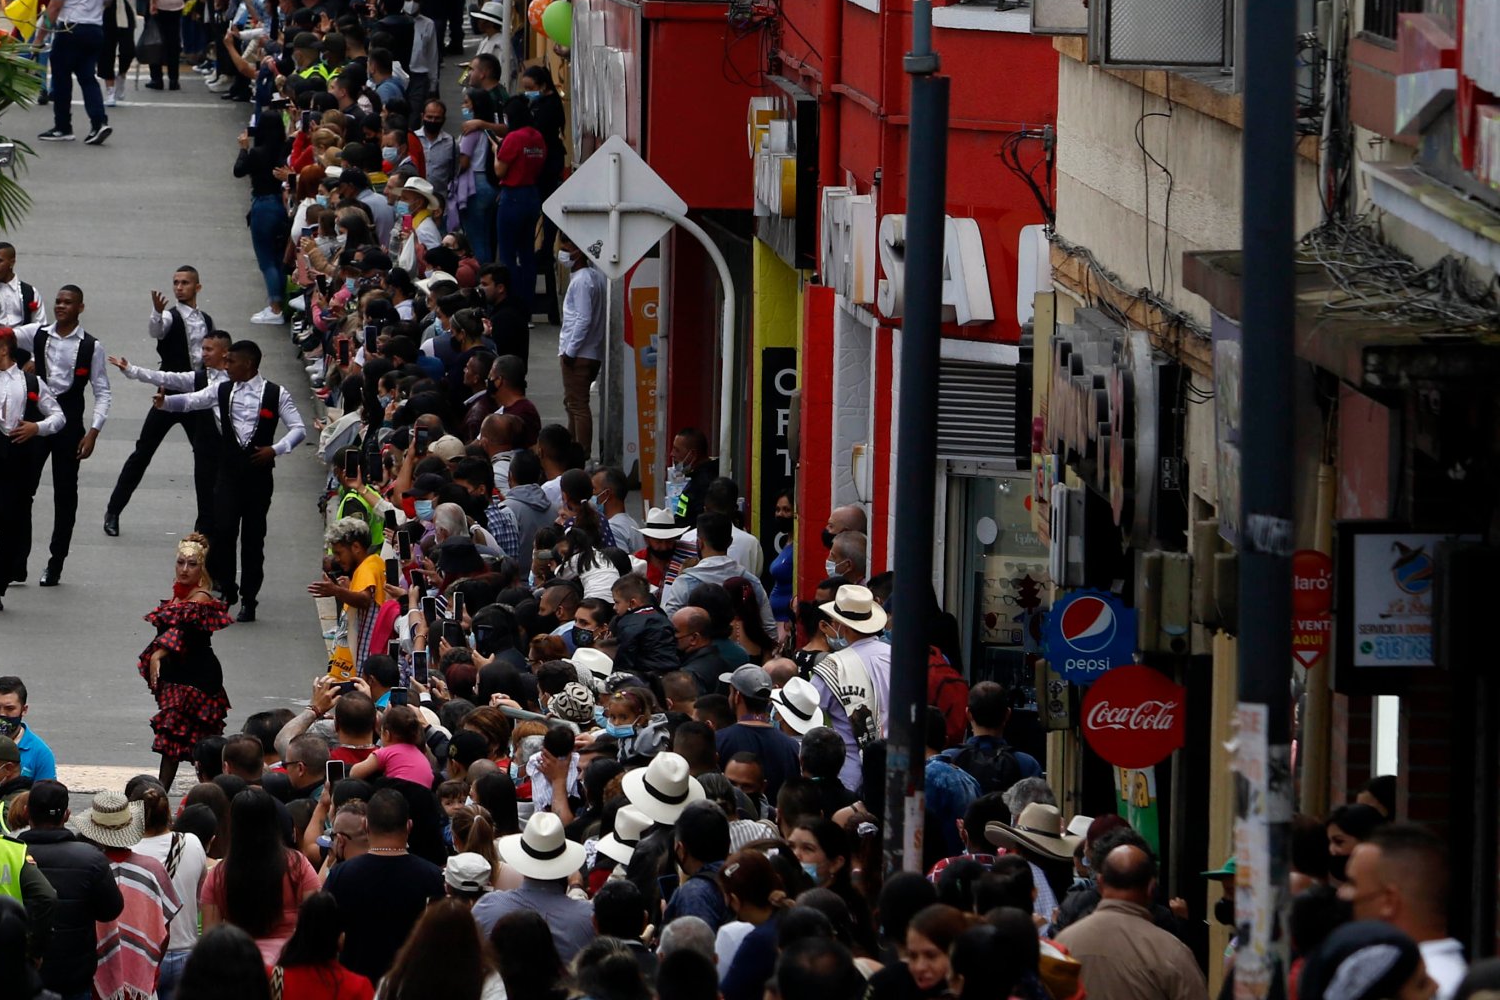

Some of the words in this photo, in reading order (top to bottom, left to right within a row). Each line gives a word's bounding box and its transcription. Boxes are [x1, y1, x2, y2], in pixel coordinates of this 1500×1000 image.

[1298, 620, 1331, 631] VENT
[1065, 657, 1110, 672] pepsi
[1087, 700, 1179, 731] Coca-Cola
